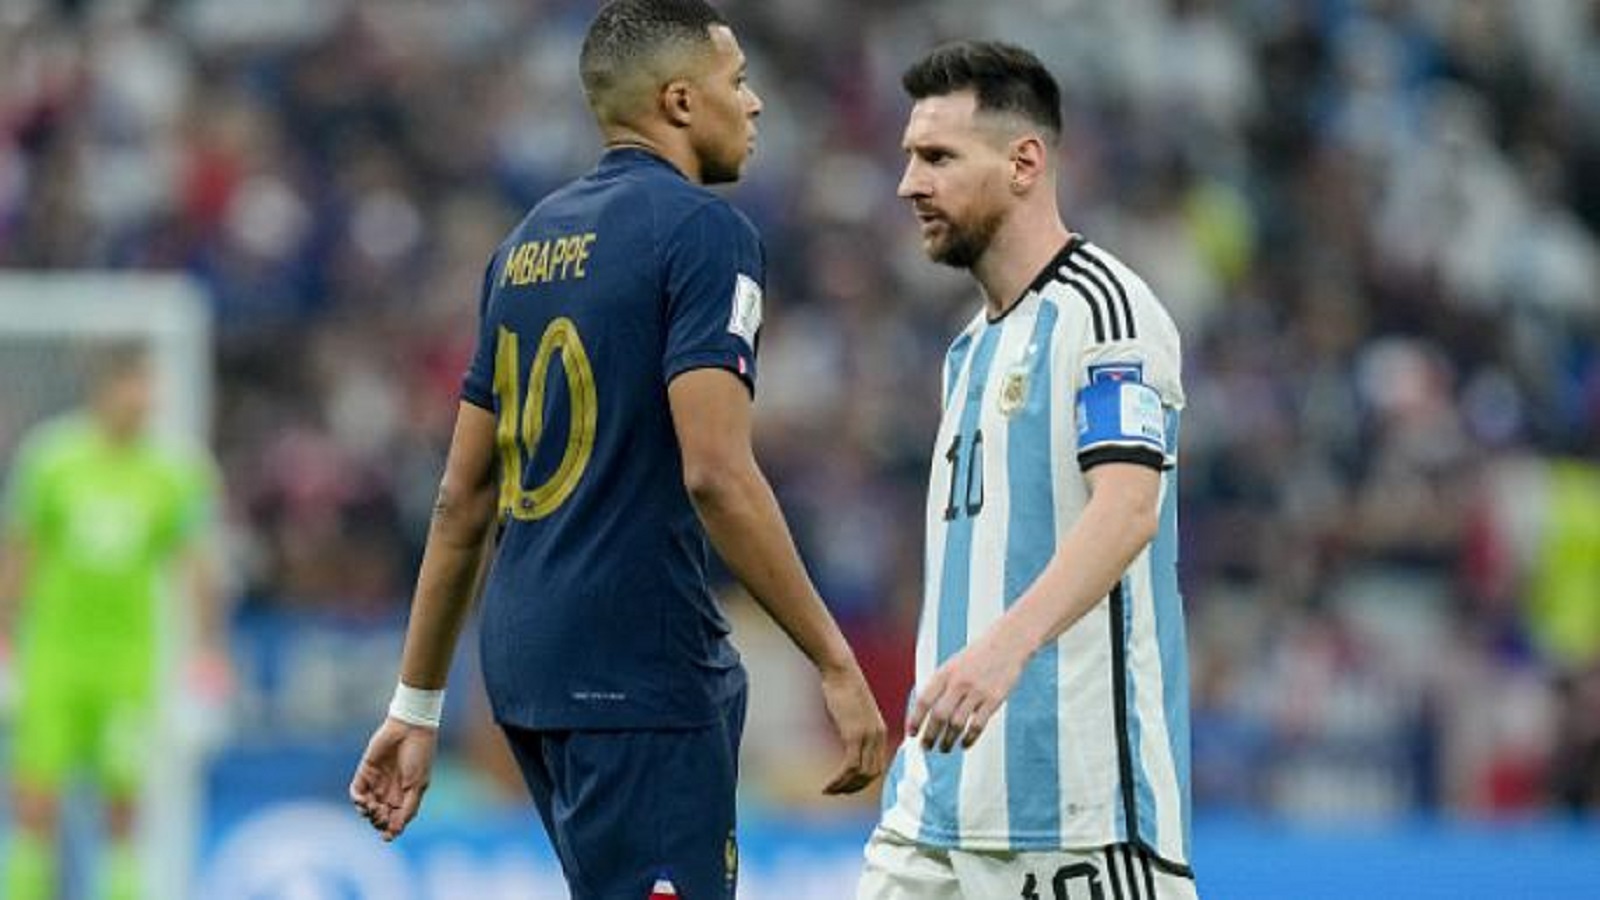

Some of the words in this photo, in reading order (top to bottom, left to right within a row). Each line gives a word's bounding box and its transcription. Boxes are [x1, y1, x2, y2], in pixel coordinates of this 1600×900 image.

[500, 233, 597, 288] MBAPPE
[494, 317, 598, 519] 10
[945, 429, 984, 520] 10
